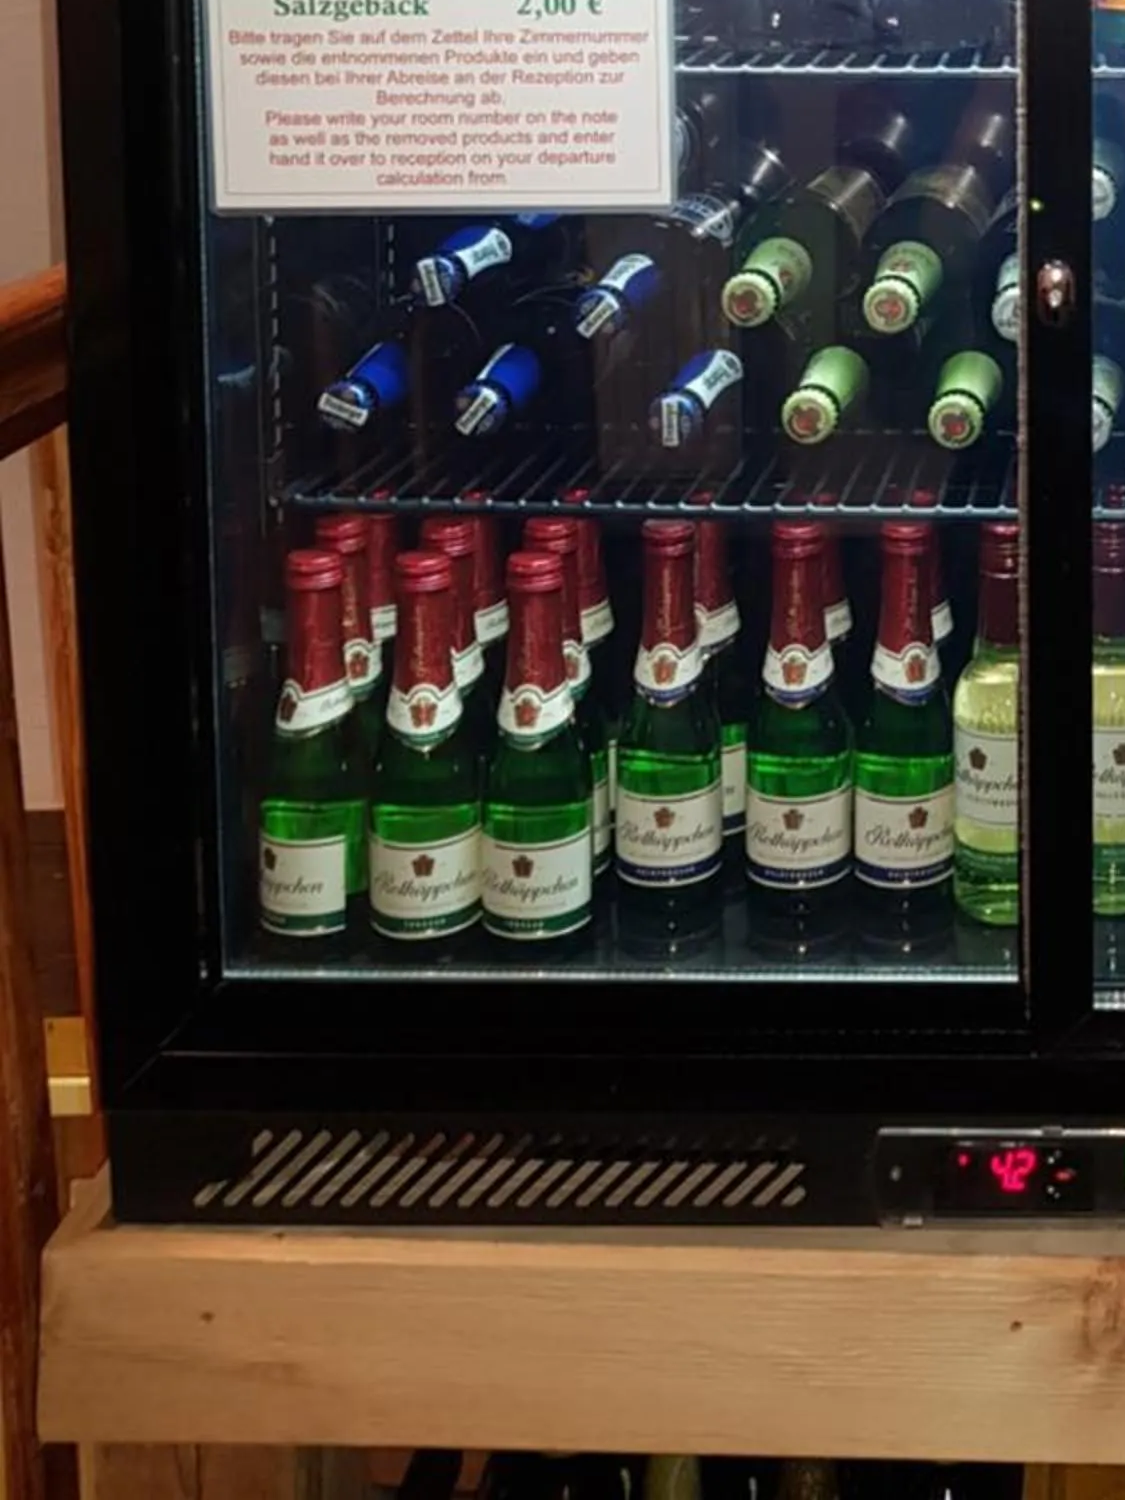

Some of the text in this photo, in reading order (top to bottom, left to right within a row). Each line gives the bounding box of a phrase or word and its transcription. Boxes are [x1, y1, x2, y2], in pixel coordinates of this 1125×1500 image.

[228, 28, 649, 49] Bitte tragen Sie auf dem Zettel Ihre Zimmernummer
[240, 49, 640, 68] sowie die entnommenen Produkte ein und geben
[255, 69, 624, 87] diesen bei Ihrer Abreise an der Rezeption zur
[376, 89, 476, 108] Berechnung
[265, 109, 618, 128] Please write your room number on the note
[269, 130, 615, 148] as well as the removed products and enter
[269, 149, 616, 168] hand it over to reception on your departure
[376, 170, 464, 187] calculation
